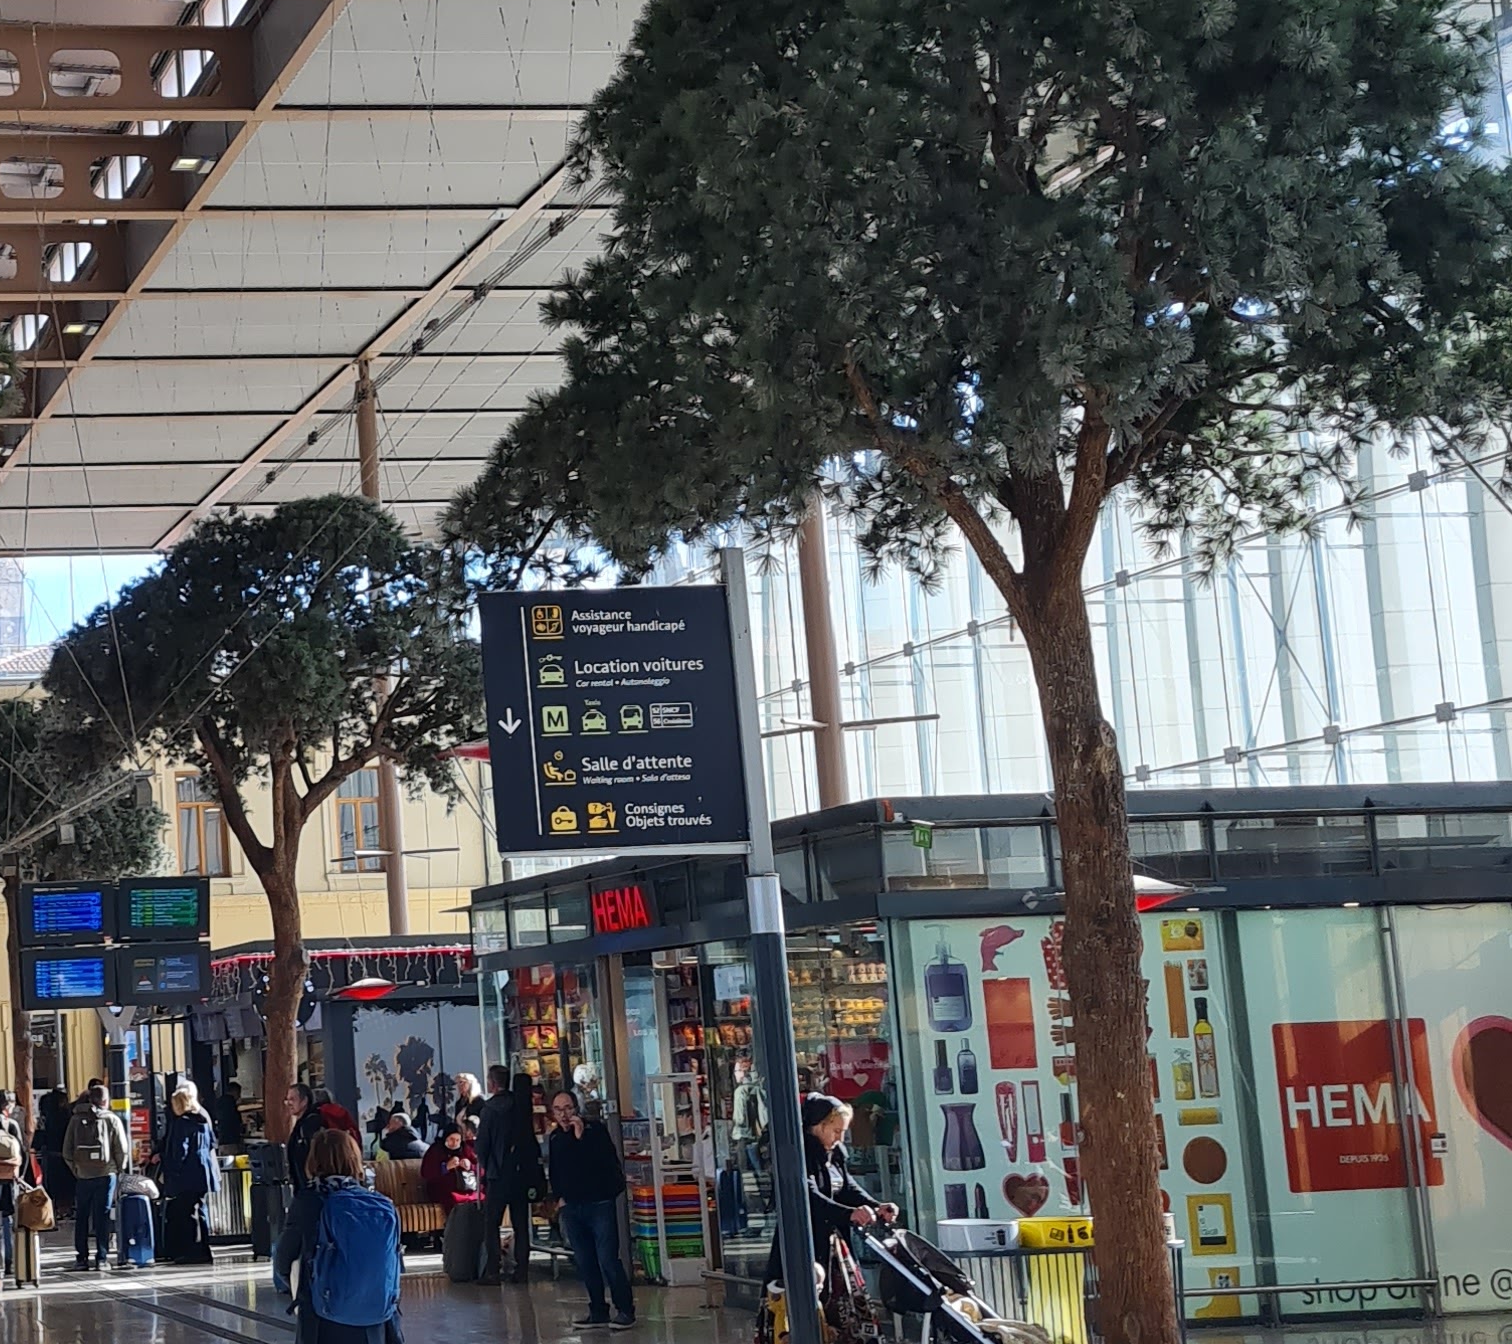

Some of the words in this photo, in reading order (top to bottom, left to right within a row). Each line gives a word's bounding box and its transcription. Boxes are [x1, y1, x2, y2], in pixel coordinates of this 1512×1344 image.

[571, 610, 632, 621] Assistance
[572, 623, 624, 636] voyageur
[627, 619, 686, 633] handicapé
[574, 658, 639, 674] Location
[643, 657, 704, 672] voitures
[581, 756, 619, 771] Salle
[622, 755, 692, 770] d'attente
[583, 776, 612, 785] Waiting
[625, 803, 685, 816] Consignes
[626, 816, 665, 830] Objets
[668, 814, 712, 826] trouvés
[592, 885, 648, 933] HEMA
[1286, 1083, 1431, 1128] HEMA
